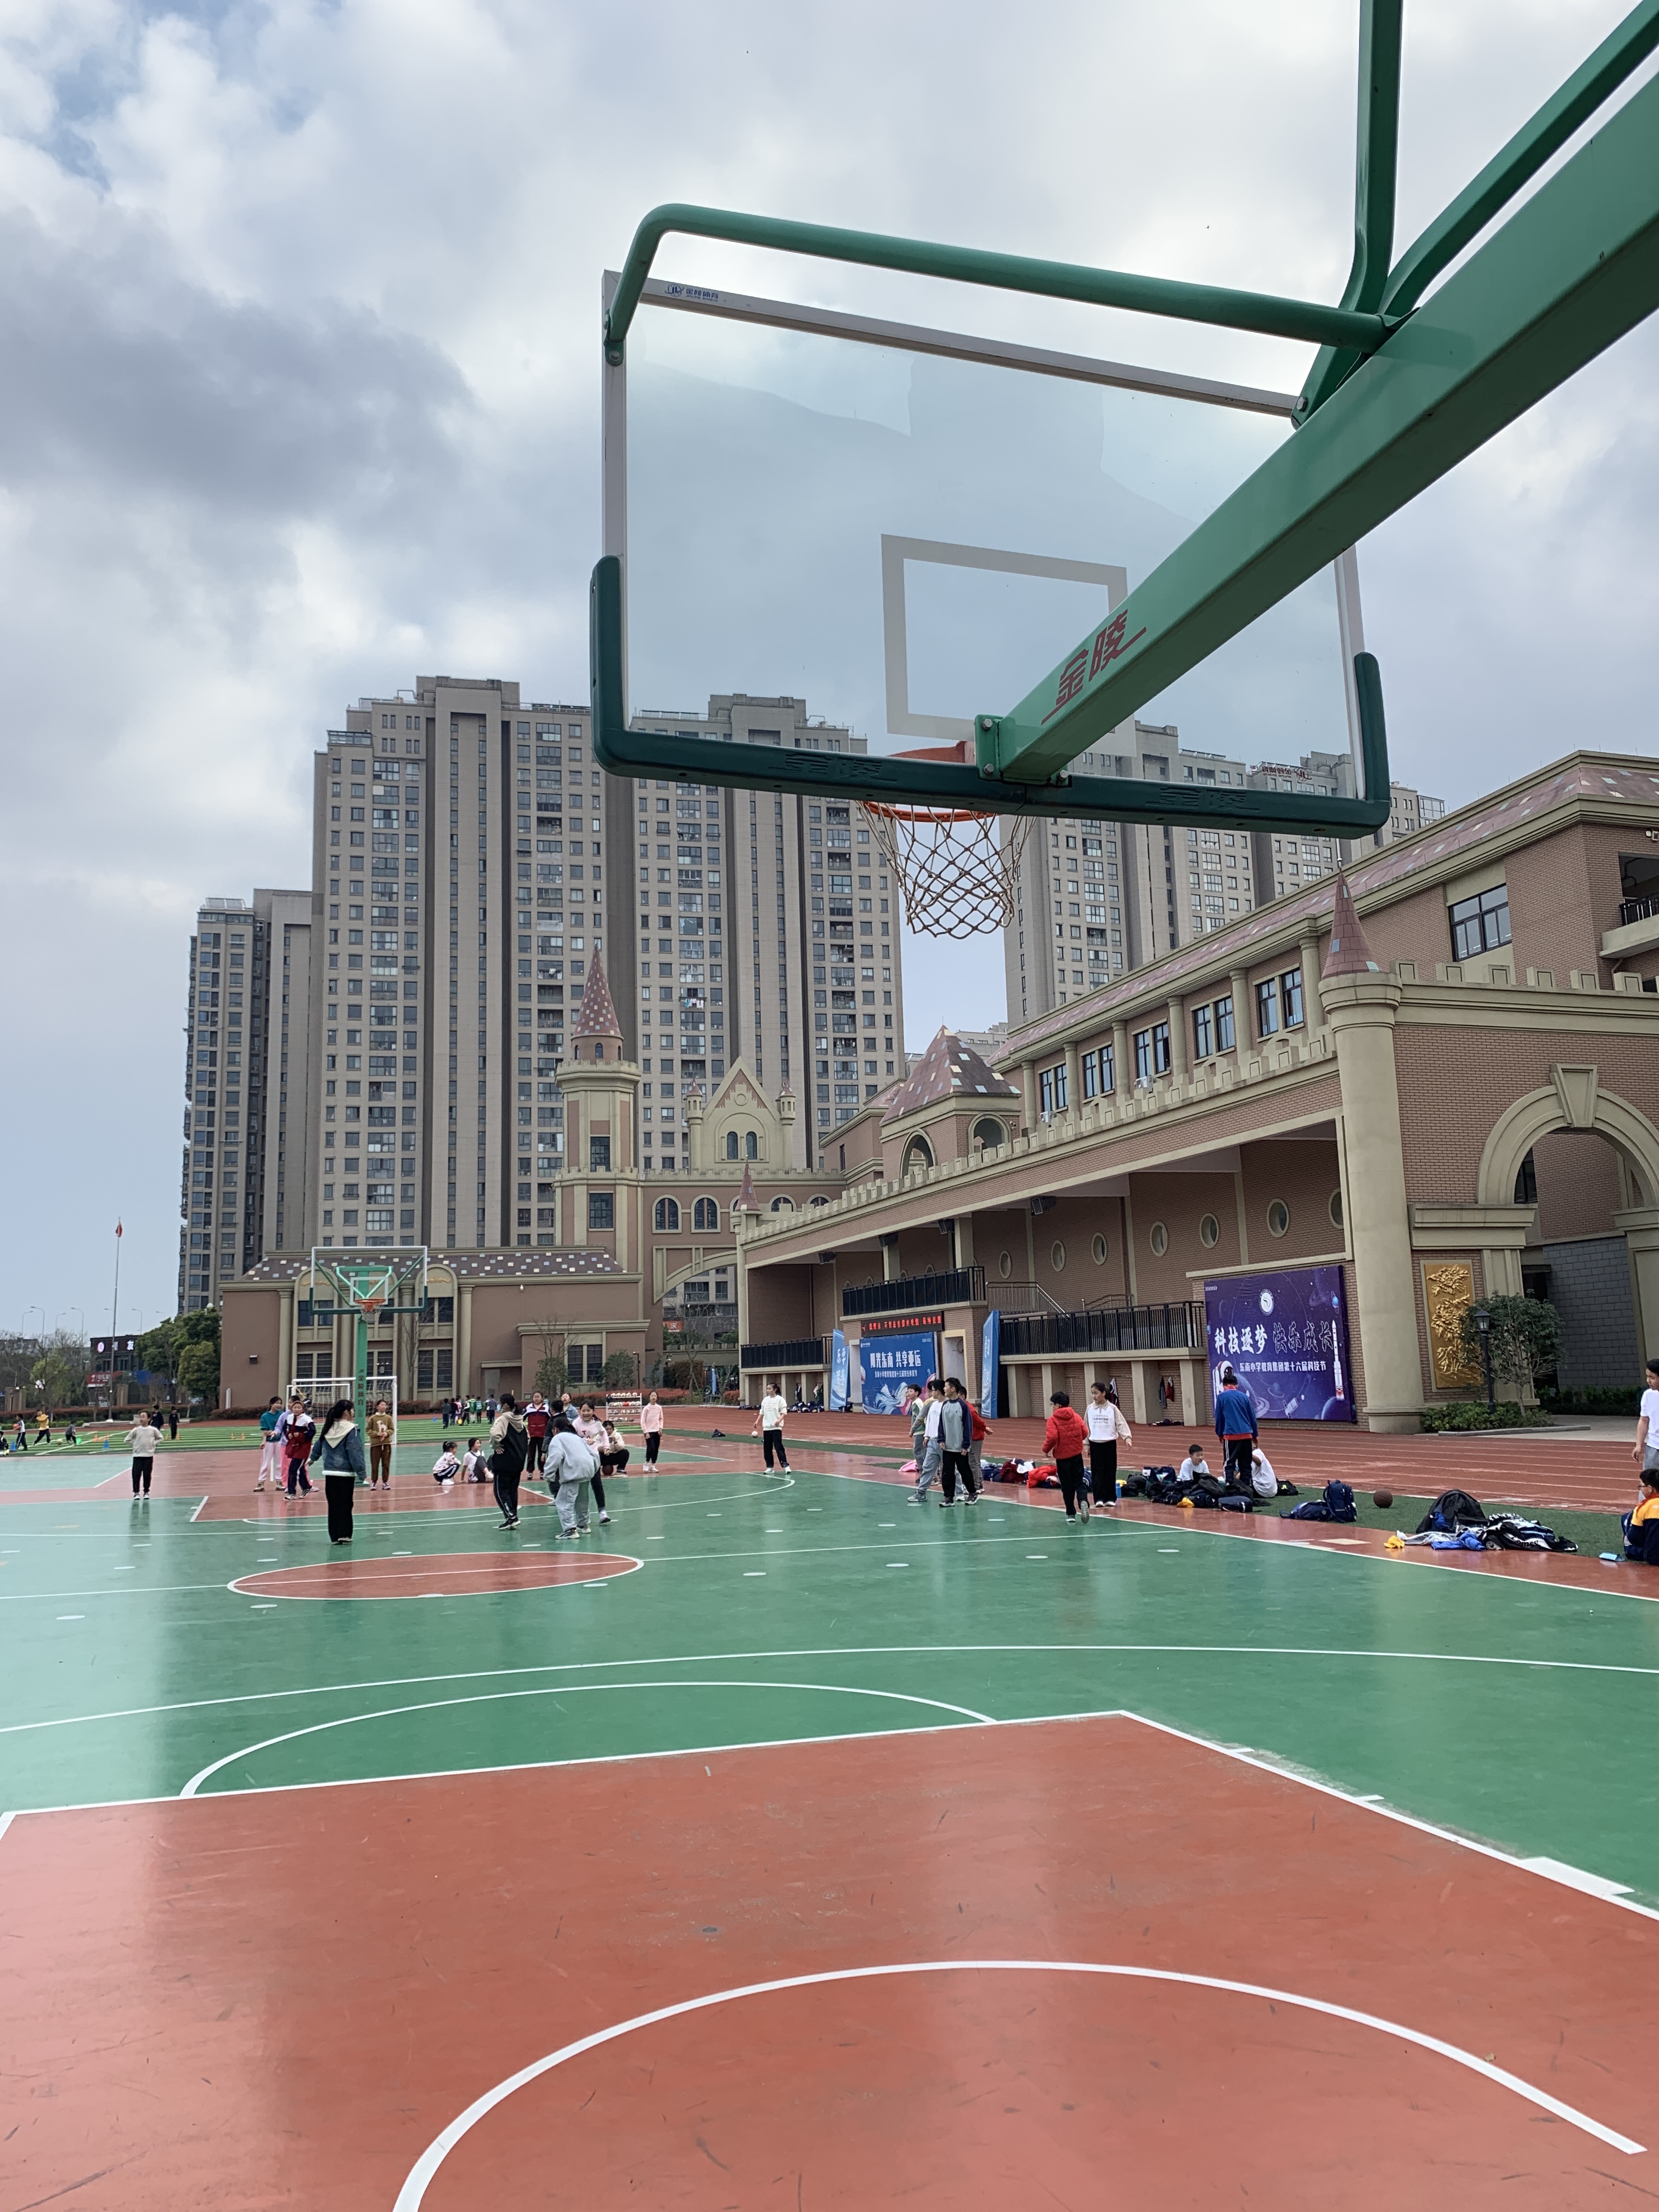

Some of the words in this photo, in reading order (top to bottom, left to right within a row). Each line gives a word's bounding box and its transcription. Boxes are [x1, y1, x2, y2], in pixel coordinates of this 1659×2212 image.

[1041, 608, 1147, 725] 金陵
[1214, 1324, 1268, 1355] 科技逐梦
[1273, 1321, 1334, 1355] 快乐成长
[870, 1351, 894, 1369] 阳光东南
[895, 1350, 922, 1368] 共享亚运
[1239, 1361, 1327, 1372] 东南小学教育集团第十六届科技节
